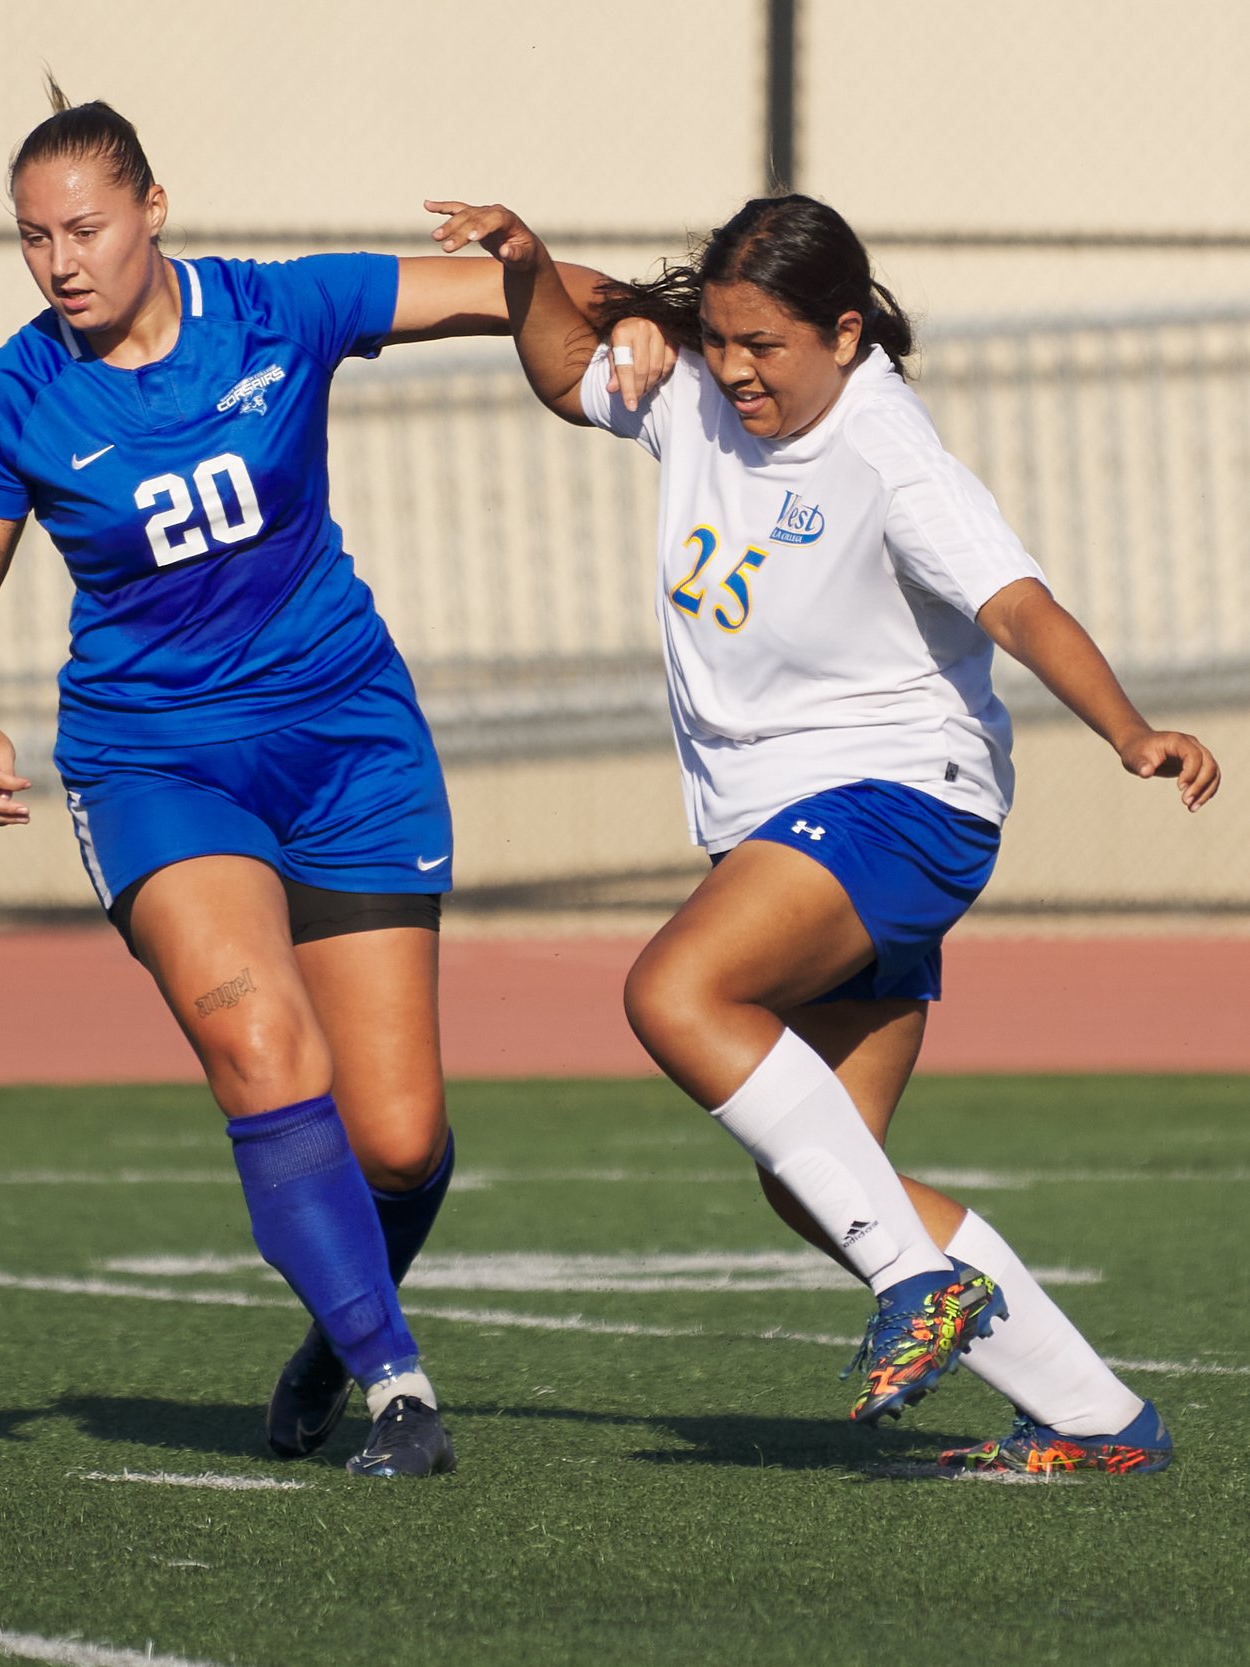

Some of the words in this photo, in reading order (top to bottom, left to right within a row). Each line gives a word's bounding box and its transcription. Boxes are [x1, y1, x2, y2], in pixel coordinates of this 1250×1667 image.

[216, 366, 286, 412] CORSAIRS
[134, 453, 264, 567] 20
[669, 524, 769, 634] 25
